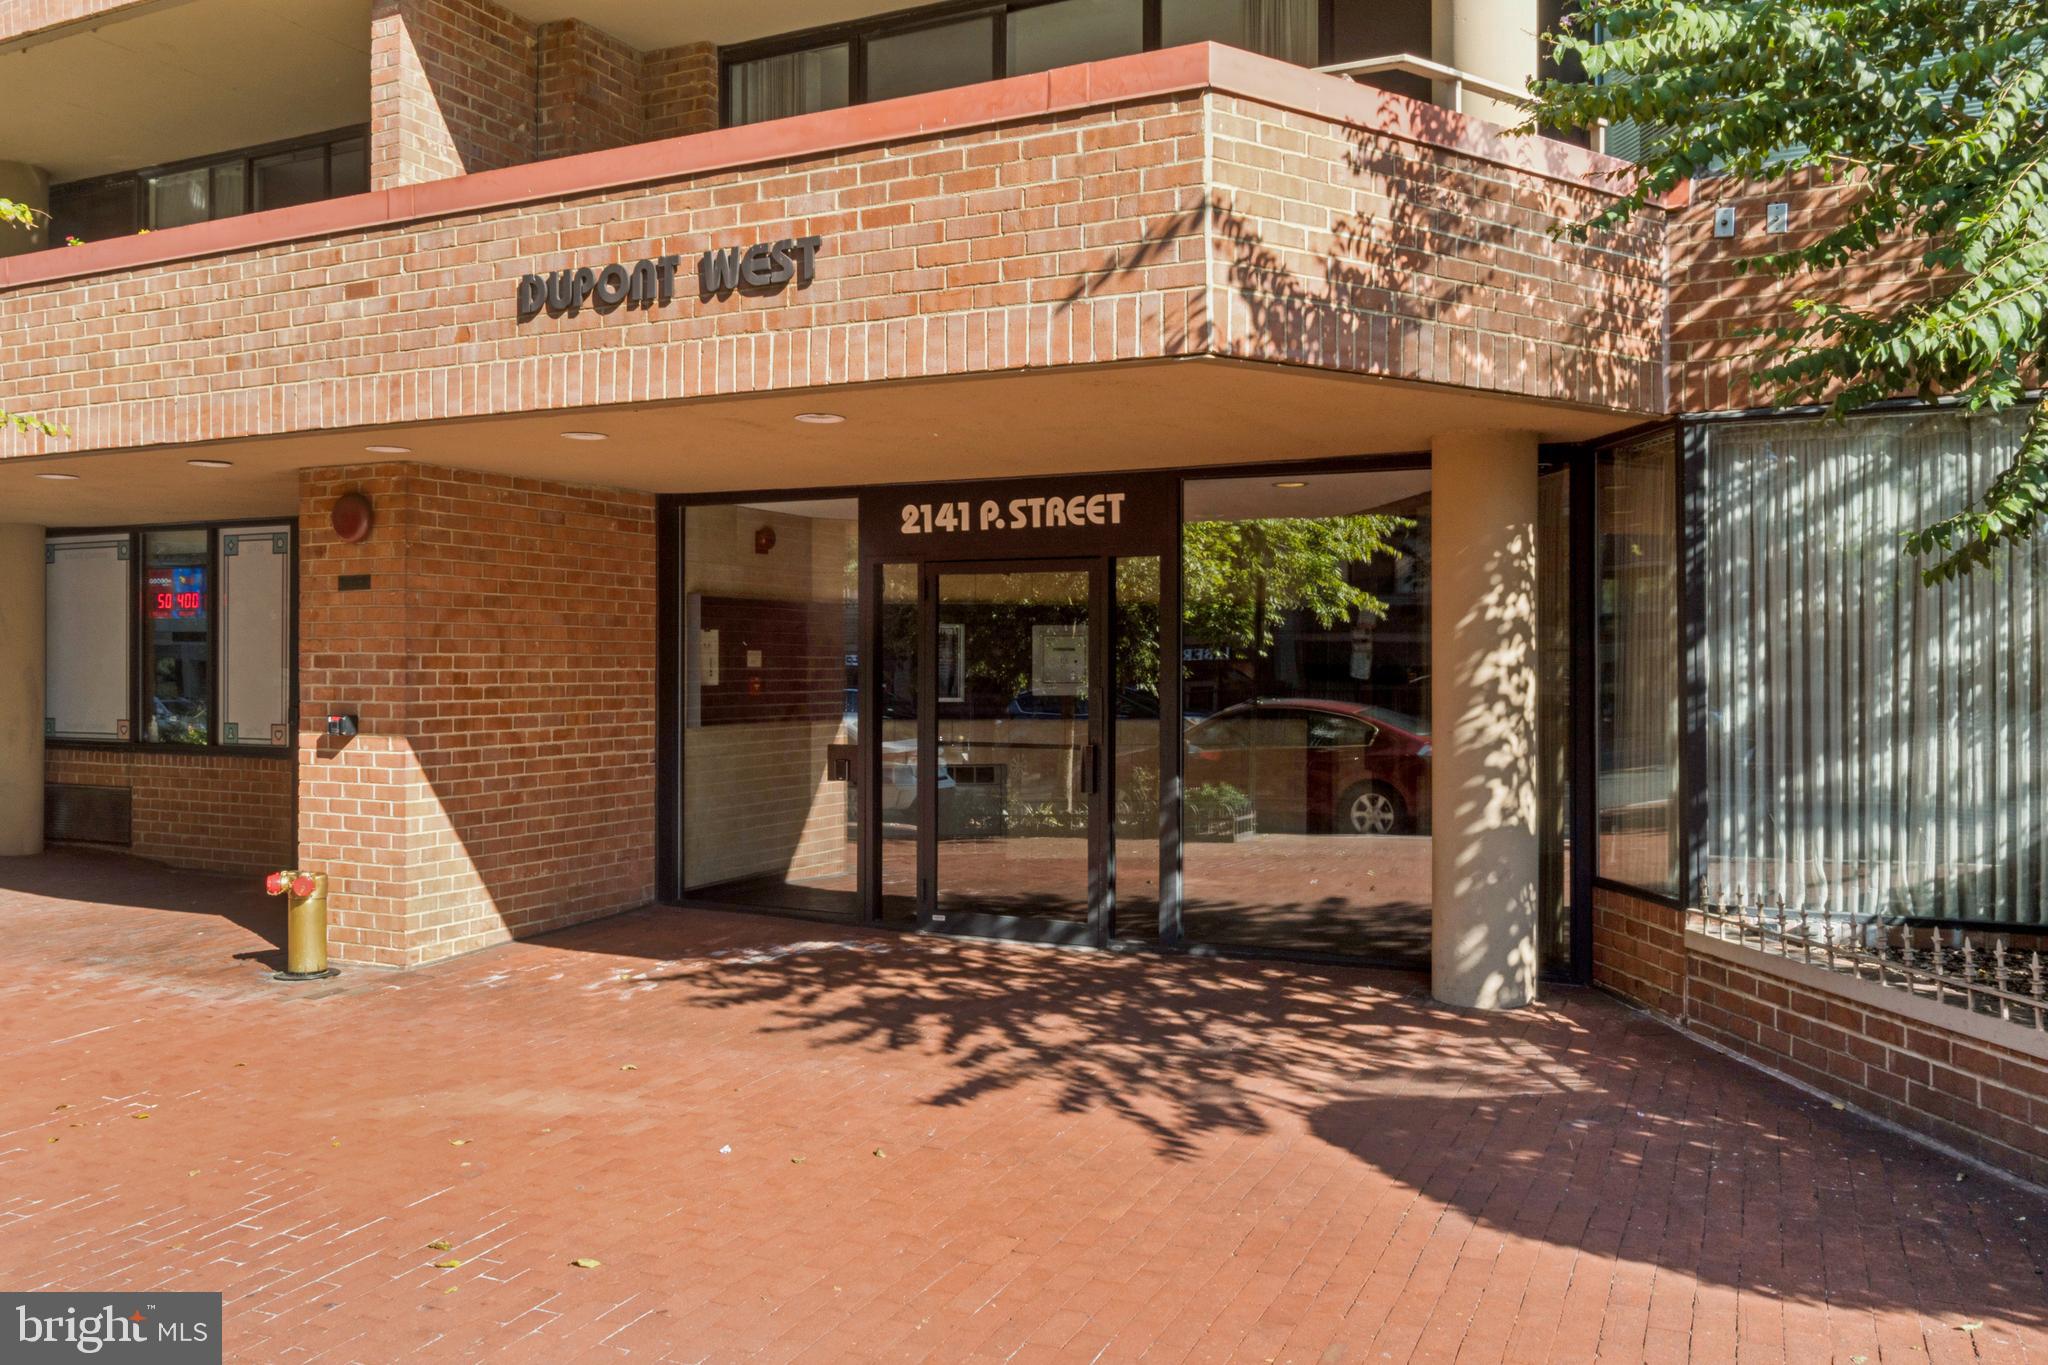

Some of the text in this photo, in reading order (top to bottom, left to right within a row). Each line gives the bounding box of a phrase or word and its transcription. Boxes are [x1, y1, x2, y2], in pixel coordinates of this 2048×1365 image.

[521, 235, 822, 315] DUPONT WEST
[901, 502, 970, 534] 2141
[157, 592, 199, 609] 50 400
